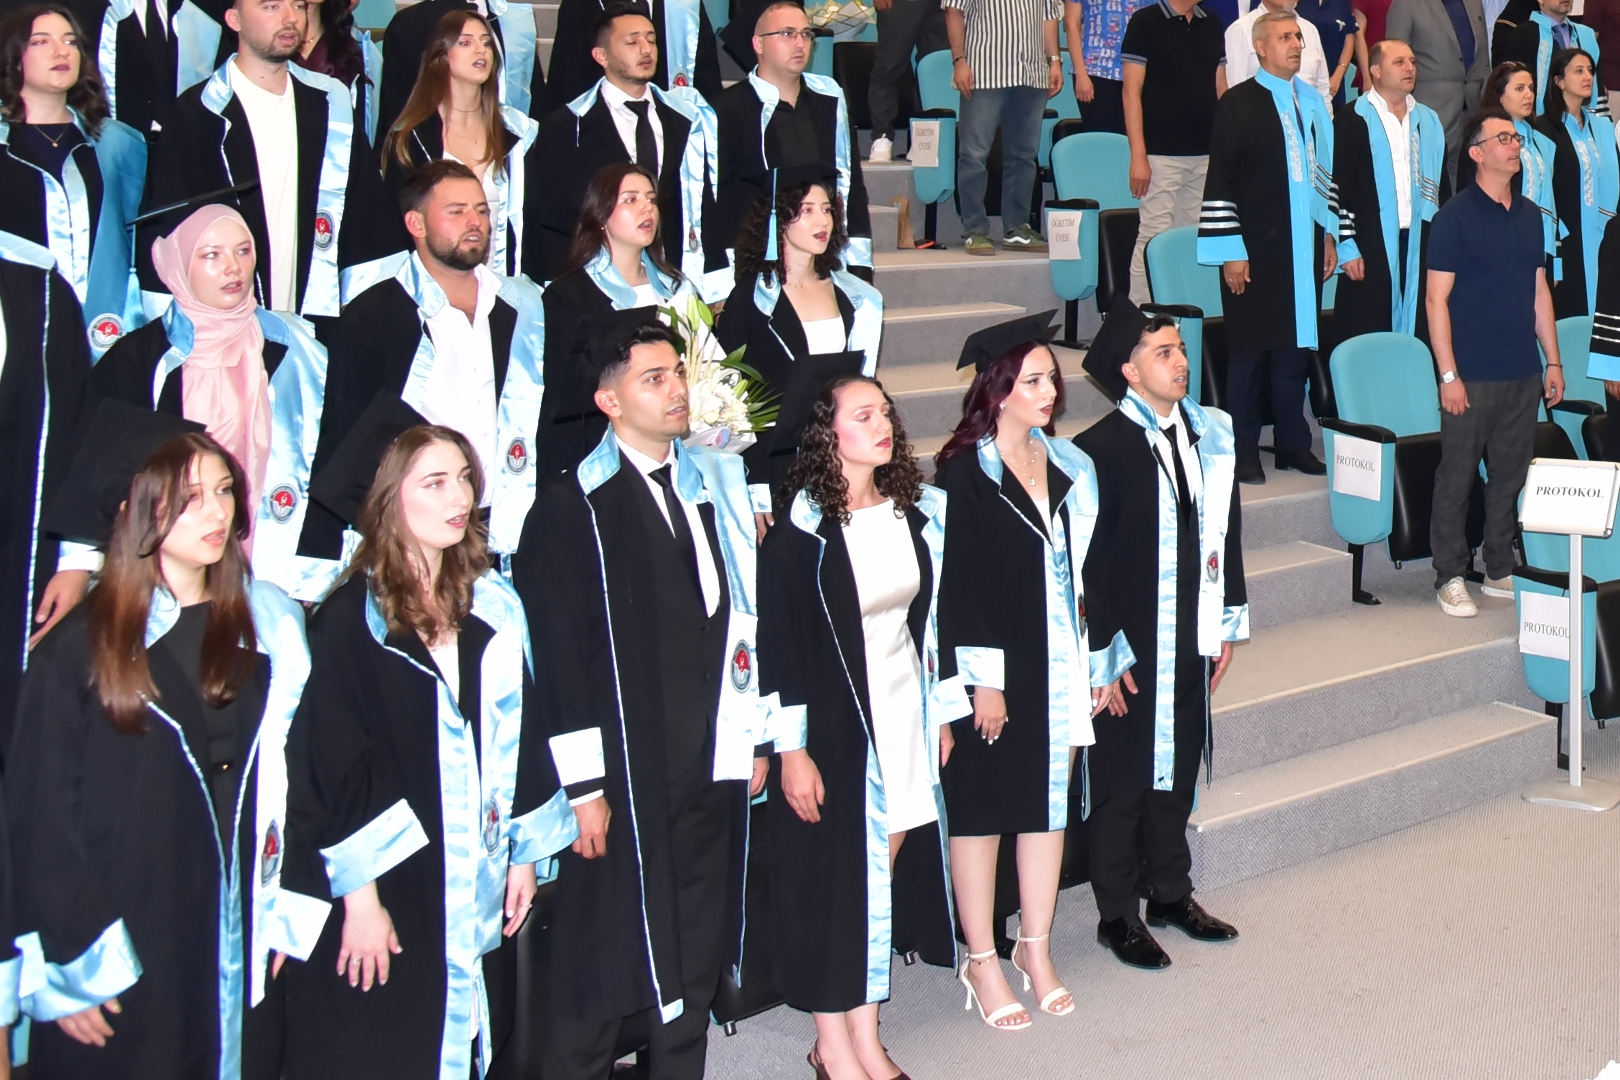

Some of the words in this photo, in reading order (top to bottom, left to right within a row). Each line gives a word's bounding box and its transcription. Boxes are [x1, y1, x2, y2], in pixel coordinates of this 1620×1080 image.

[1336, 454, 1376, 472] PROTOKOL
[1535, 485, 1605, 499] PROTOKOL
[1523, 620, 1570, 639] PROTOKOL
